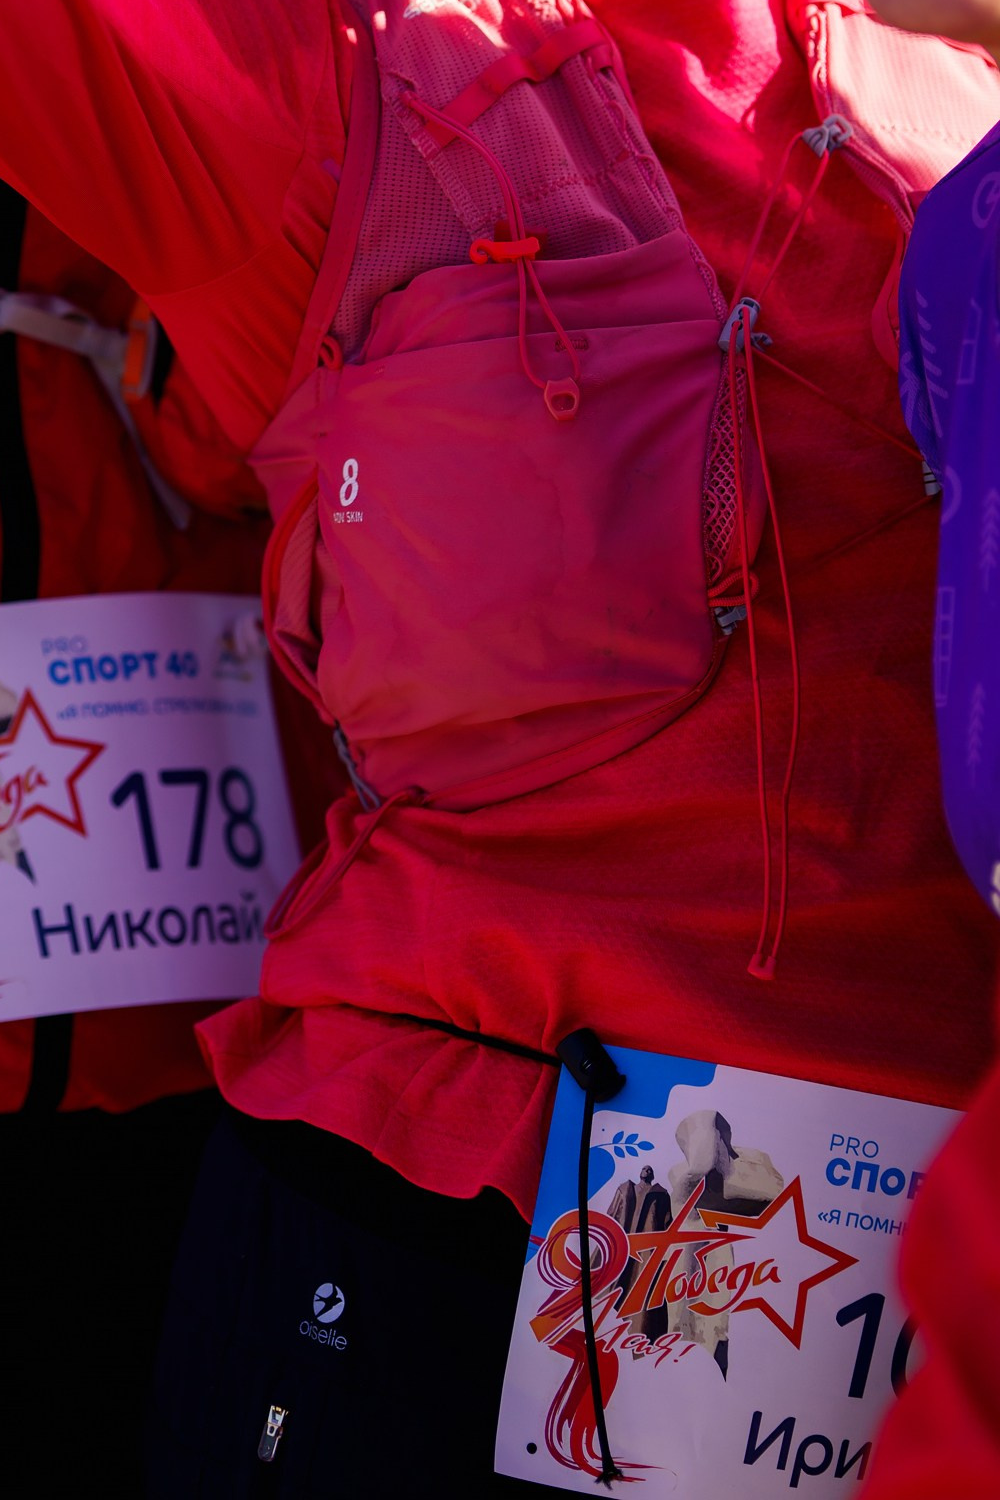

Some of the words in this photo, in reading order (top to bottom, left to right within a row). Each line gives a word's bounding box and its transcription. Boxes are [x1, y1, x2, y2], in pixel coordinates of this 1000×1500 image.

[339, 457, 359, 507] 8
[48, 652, 159, 685] СПОРТ
[110, 766, 264, 871] 178
[32, 889, 263, 959] Николай
[829, 1133, 880, 1159] PRO
[817, 1209, 842, 1225] «Я
[615, 1177, 782, 1317] Победа
[299, 1320, 348, 1351] oiselle
